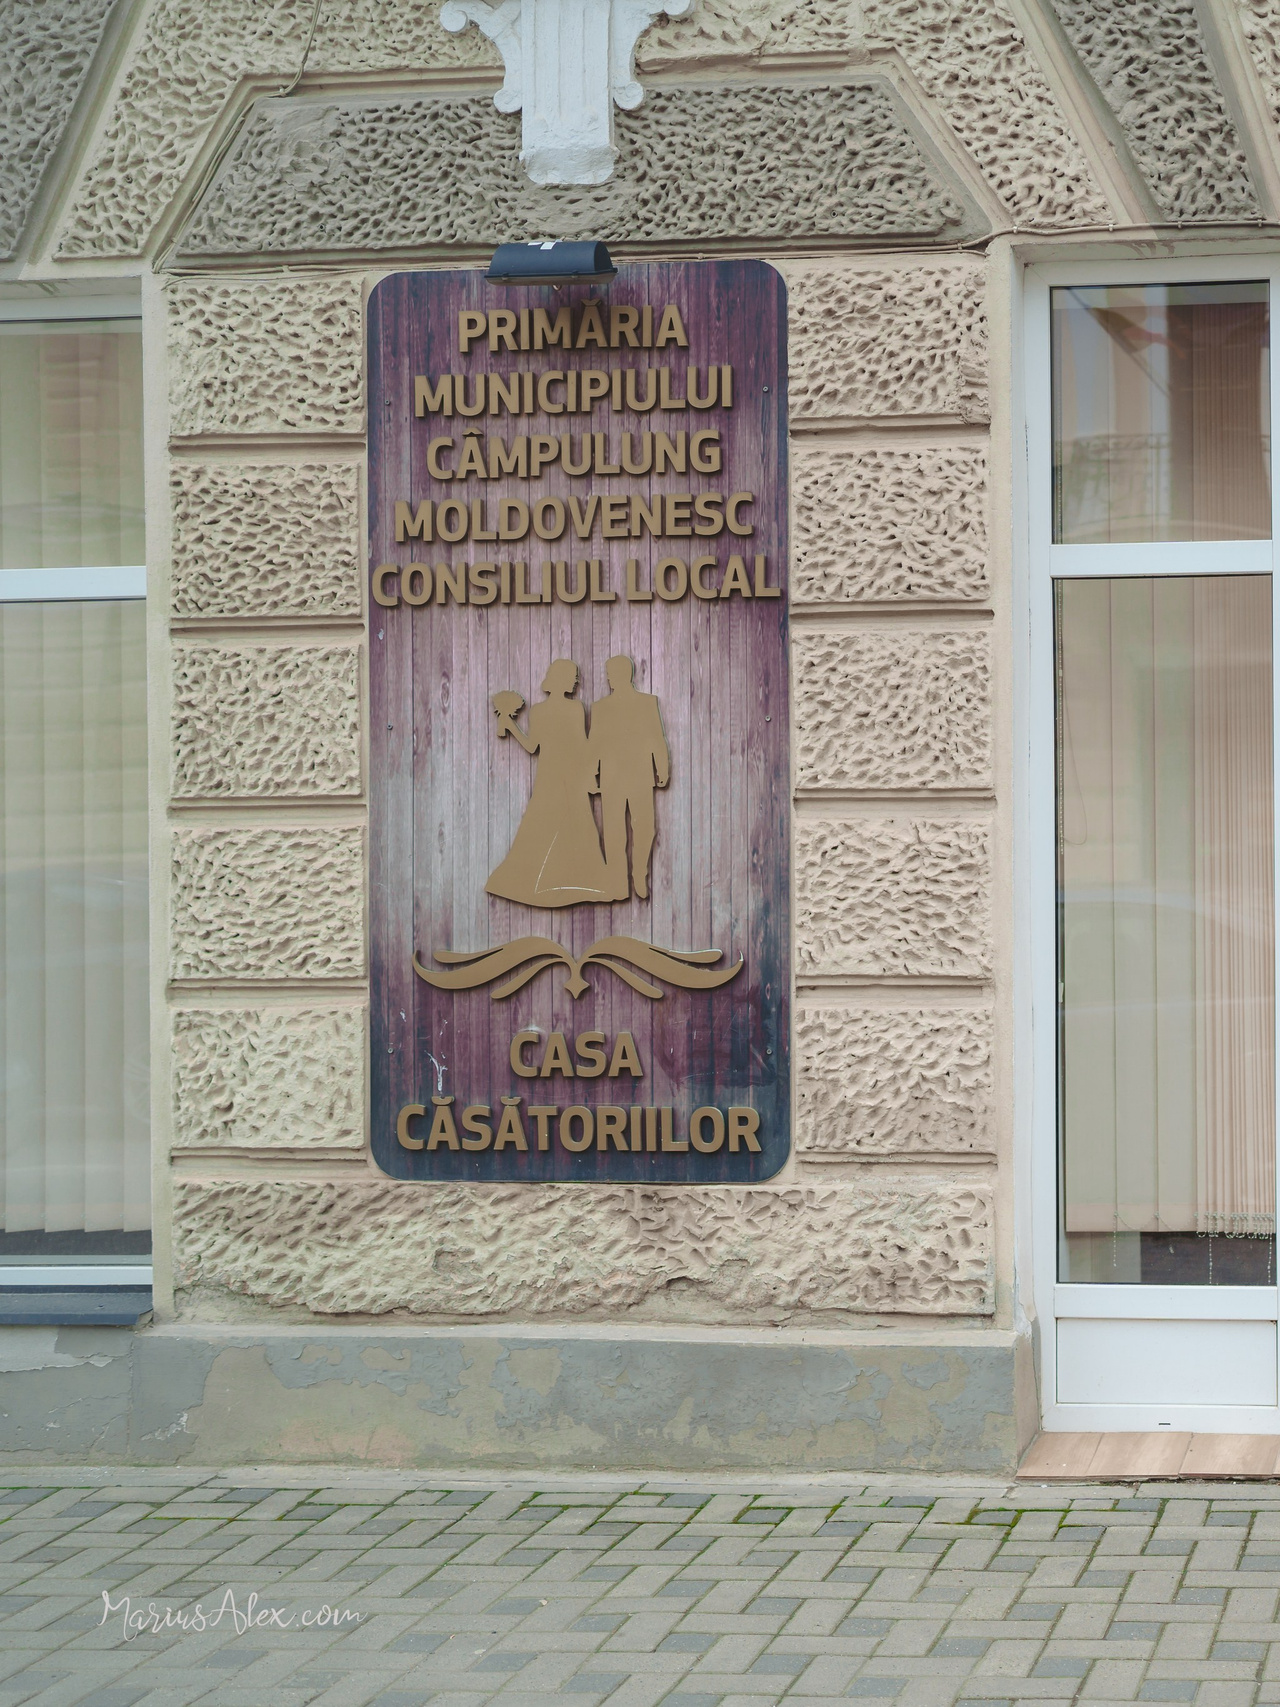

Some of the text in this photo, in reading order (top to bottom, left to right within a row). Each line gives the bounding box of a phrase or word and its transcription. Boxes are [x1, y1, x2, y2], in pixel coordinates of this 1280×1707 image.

[458, 300, 689, 353] PRIMĂRIA
[414, 364, 733, 418] MUNICIPIULUI
[426, 427, 722, 480] CÂMPULUNG
[394, 491, 754, 543] MOLDOVENESC
[371, 554, 781, 607] CONSILIUL LOCAL
[509, 1031, 644, 1078] CASA
[396, 1095, 762, 1154] CĂSĂTORIILOR
